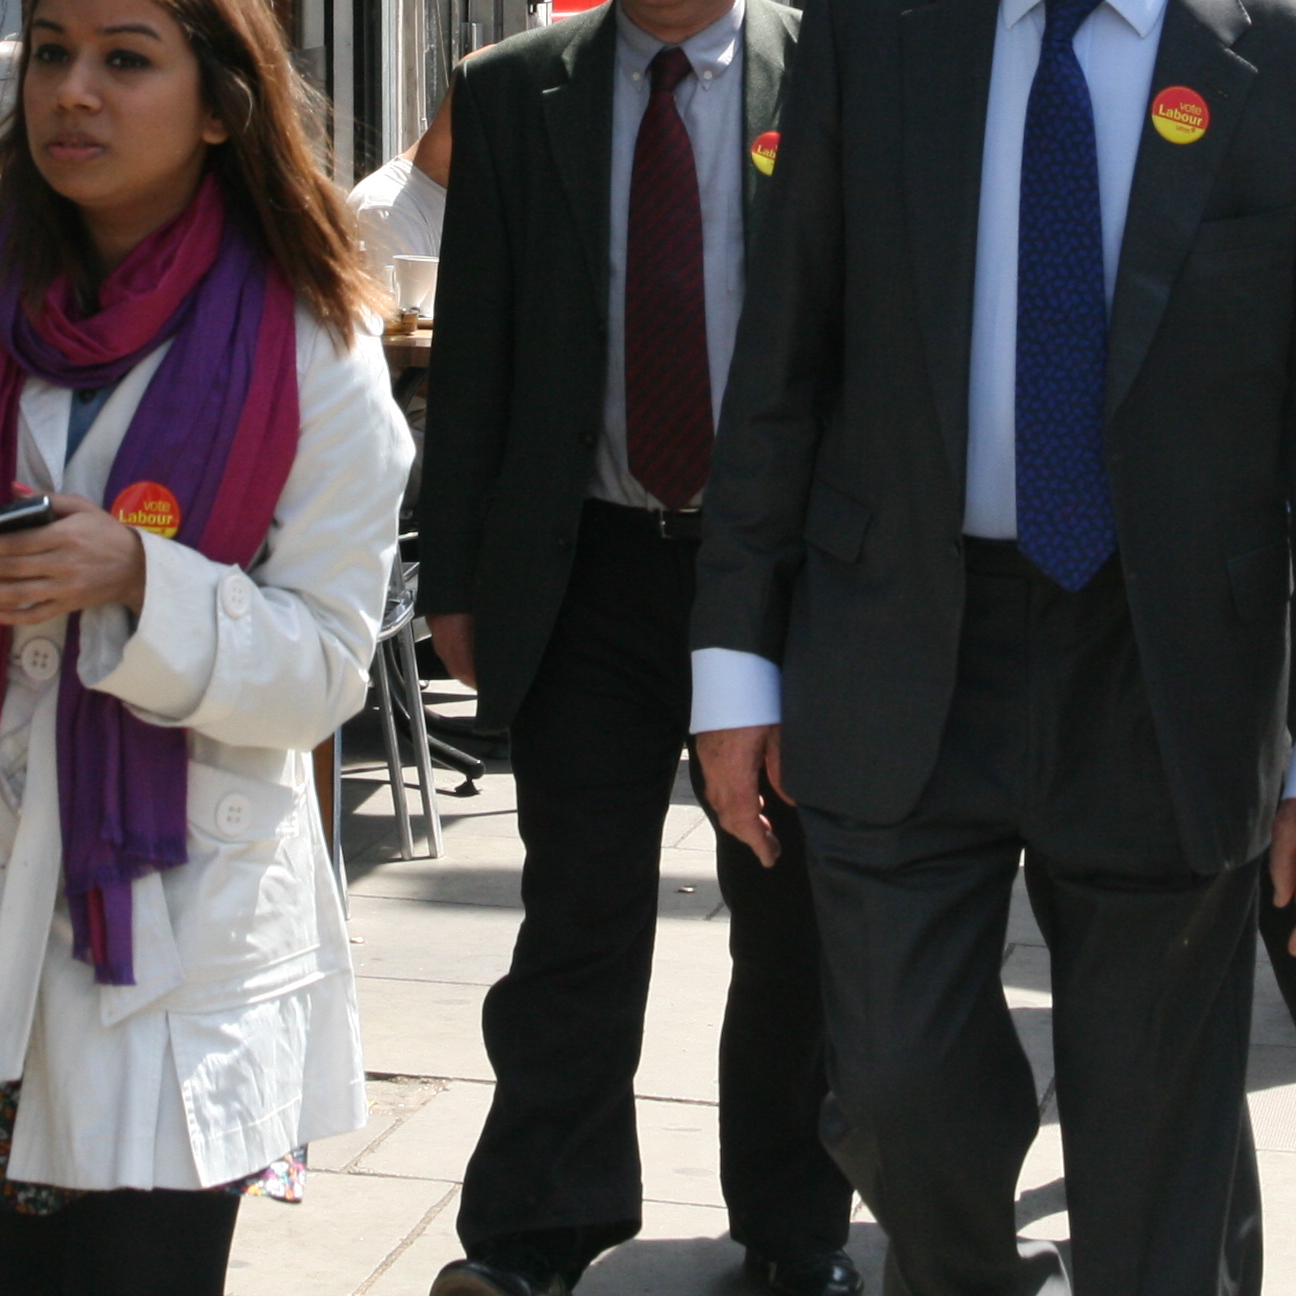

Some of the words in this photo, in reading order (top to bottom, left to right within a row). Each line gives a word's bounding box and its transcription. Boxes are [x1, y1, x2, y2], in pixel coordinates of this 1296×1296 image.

[1158, 103, 1203, 126] Labour
[1179, 101, 1202, 115] vote
[118, 508, 174, 525] Labour
